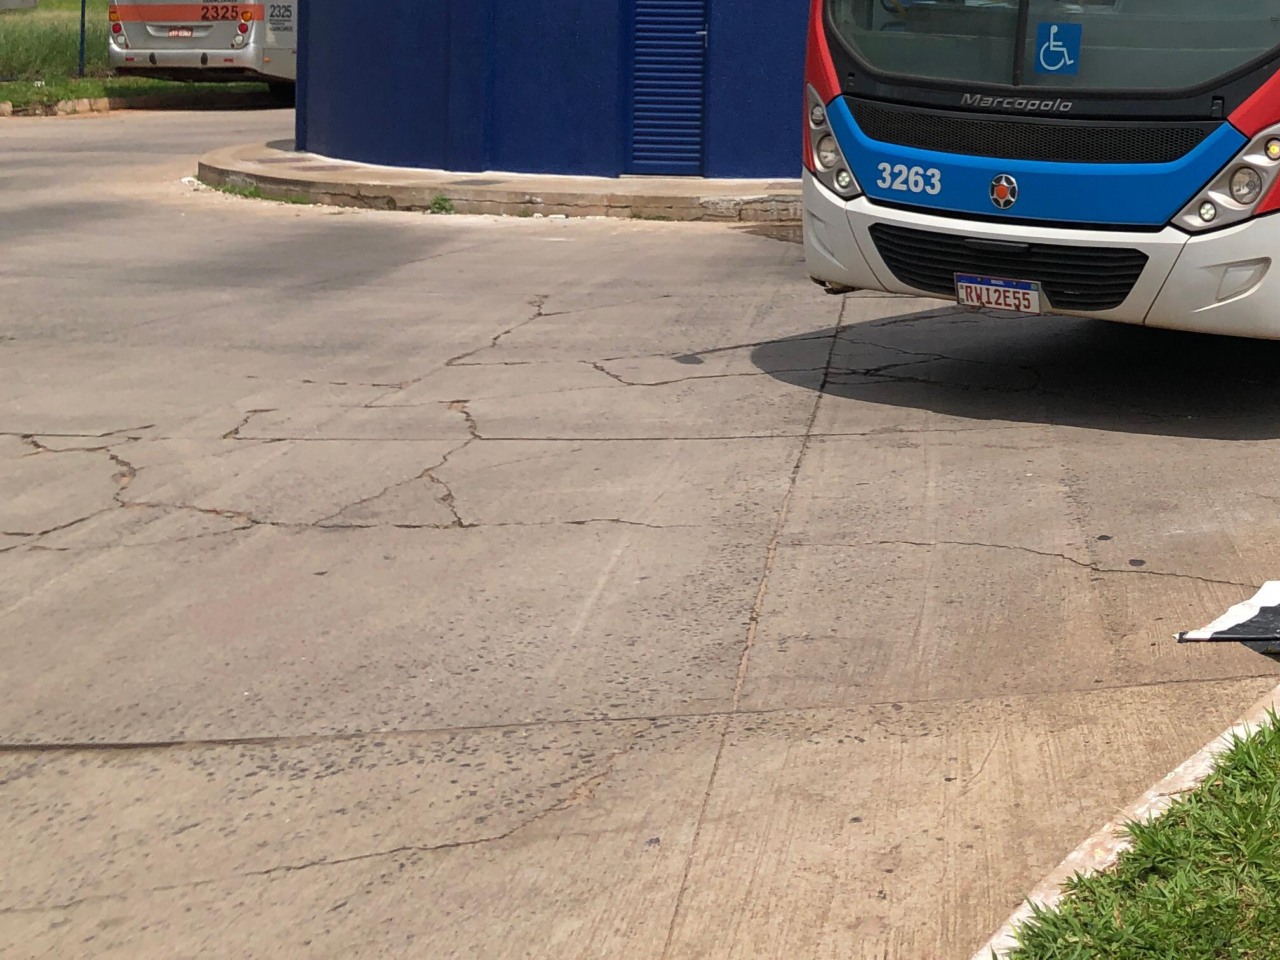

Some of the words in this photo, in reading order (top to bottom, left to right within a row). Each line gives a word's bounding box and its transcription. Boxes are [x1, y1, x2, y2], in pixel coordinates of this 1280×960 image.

[201, 5, 239, 20] 2325
[270, 4, 293, 18] 2325
[960, 93, 1073, 112] Marcopolo
[876, 162, 942, 195] 3263
[964, 285, 1031, 310] RWI2E55
